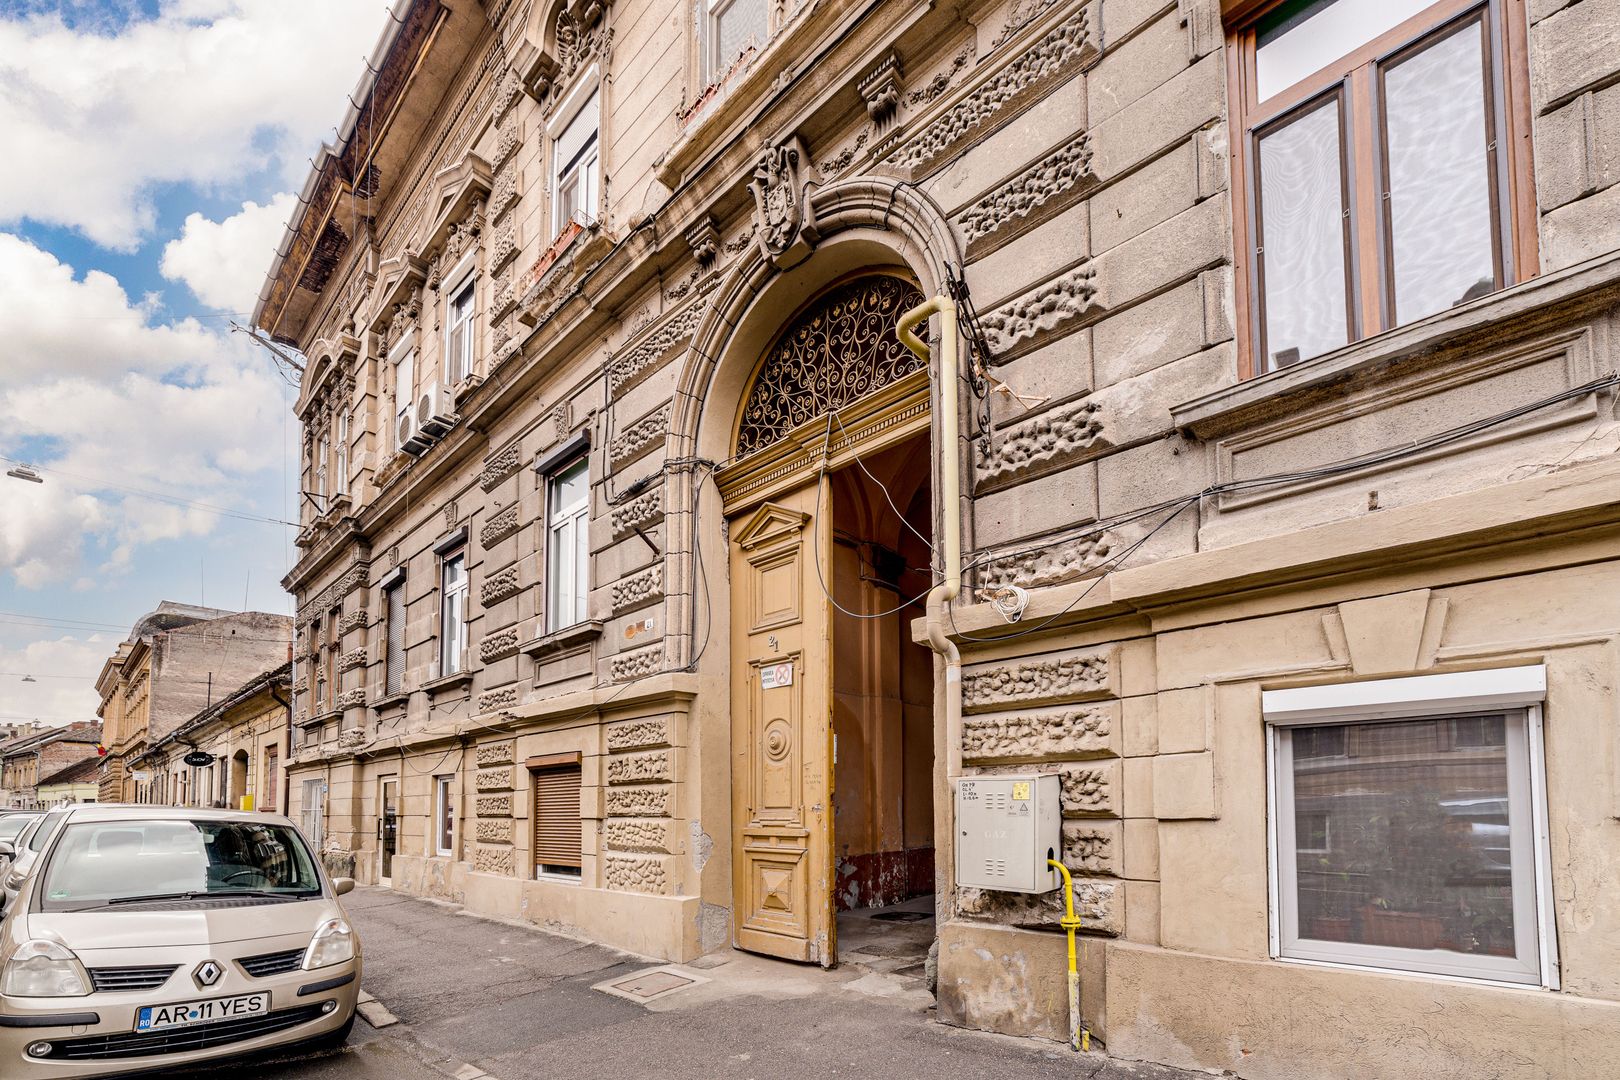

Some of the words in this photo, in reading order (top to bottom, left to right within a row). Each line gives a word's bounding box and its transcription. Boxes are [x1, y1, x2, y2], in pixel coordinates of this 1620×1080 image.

[768, 635, 779, 652] 21
[153, 1006, 190, 1026] AR
[198, 1002, 213, 1019] 11
[219, 996, 262, 1016] YES
[139, 1019, 150, 1027] RO
